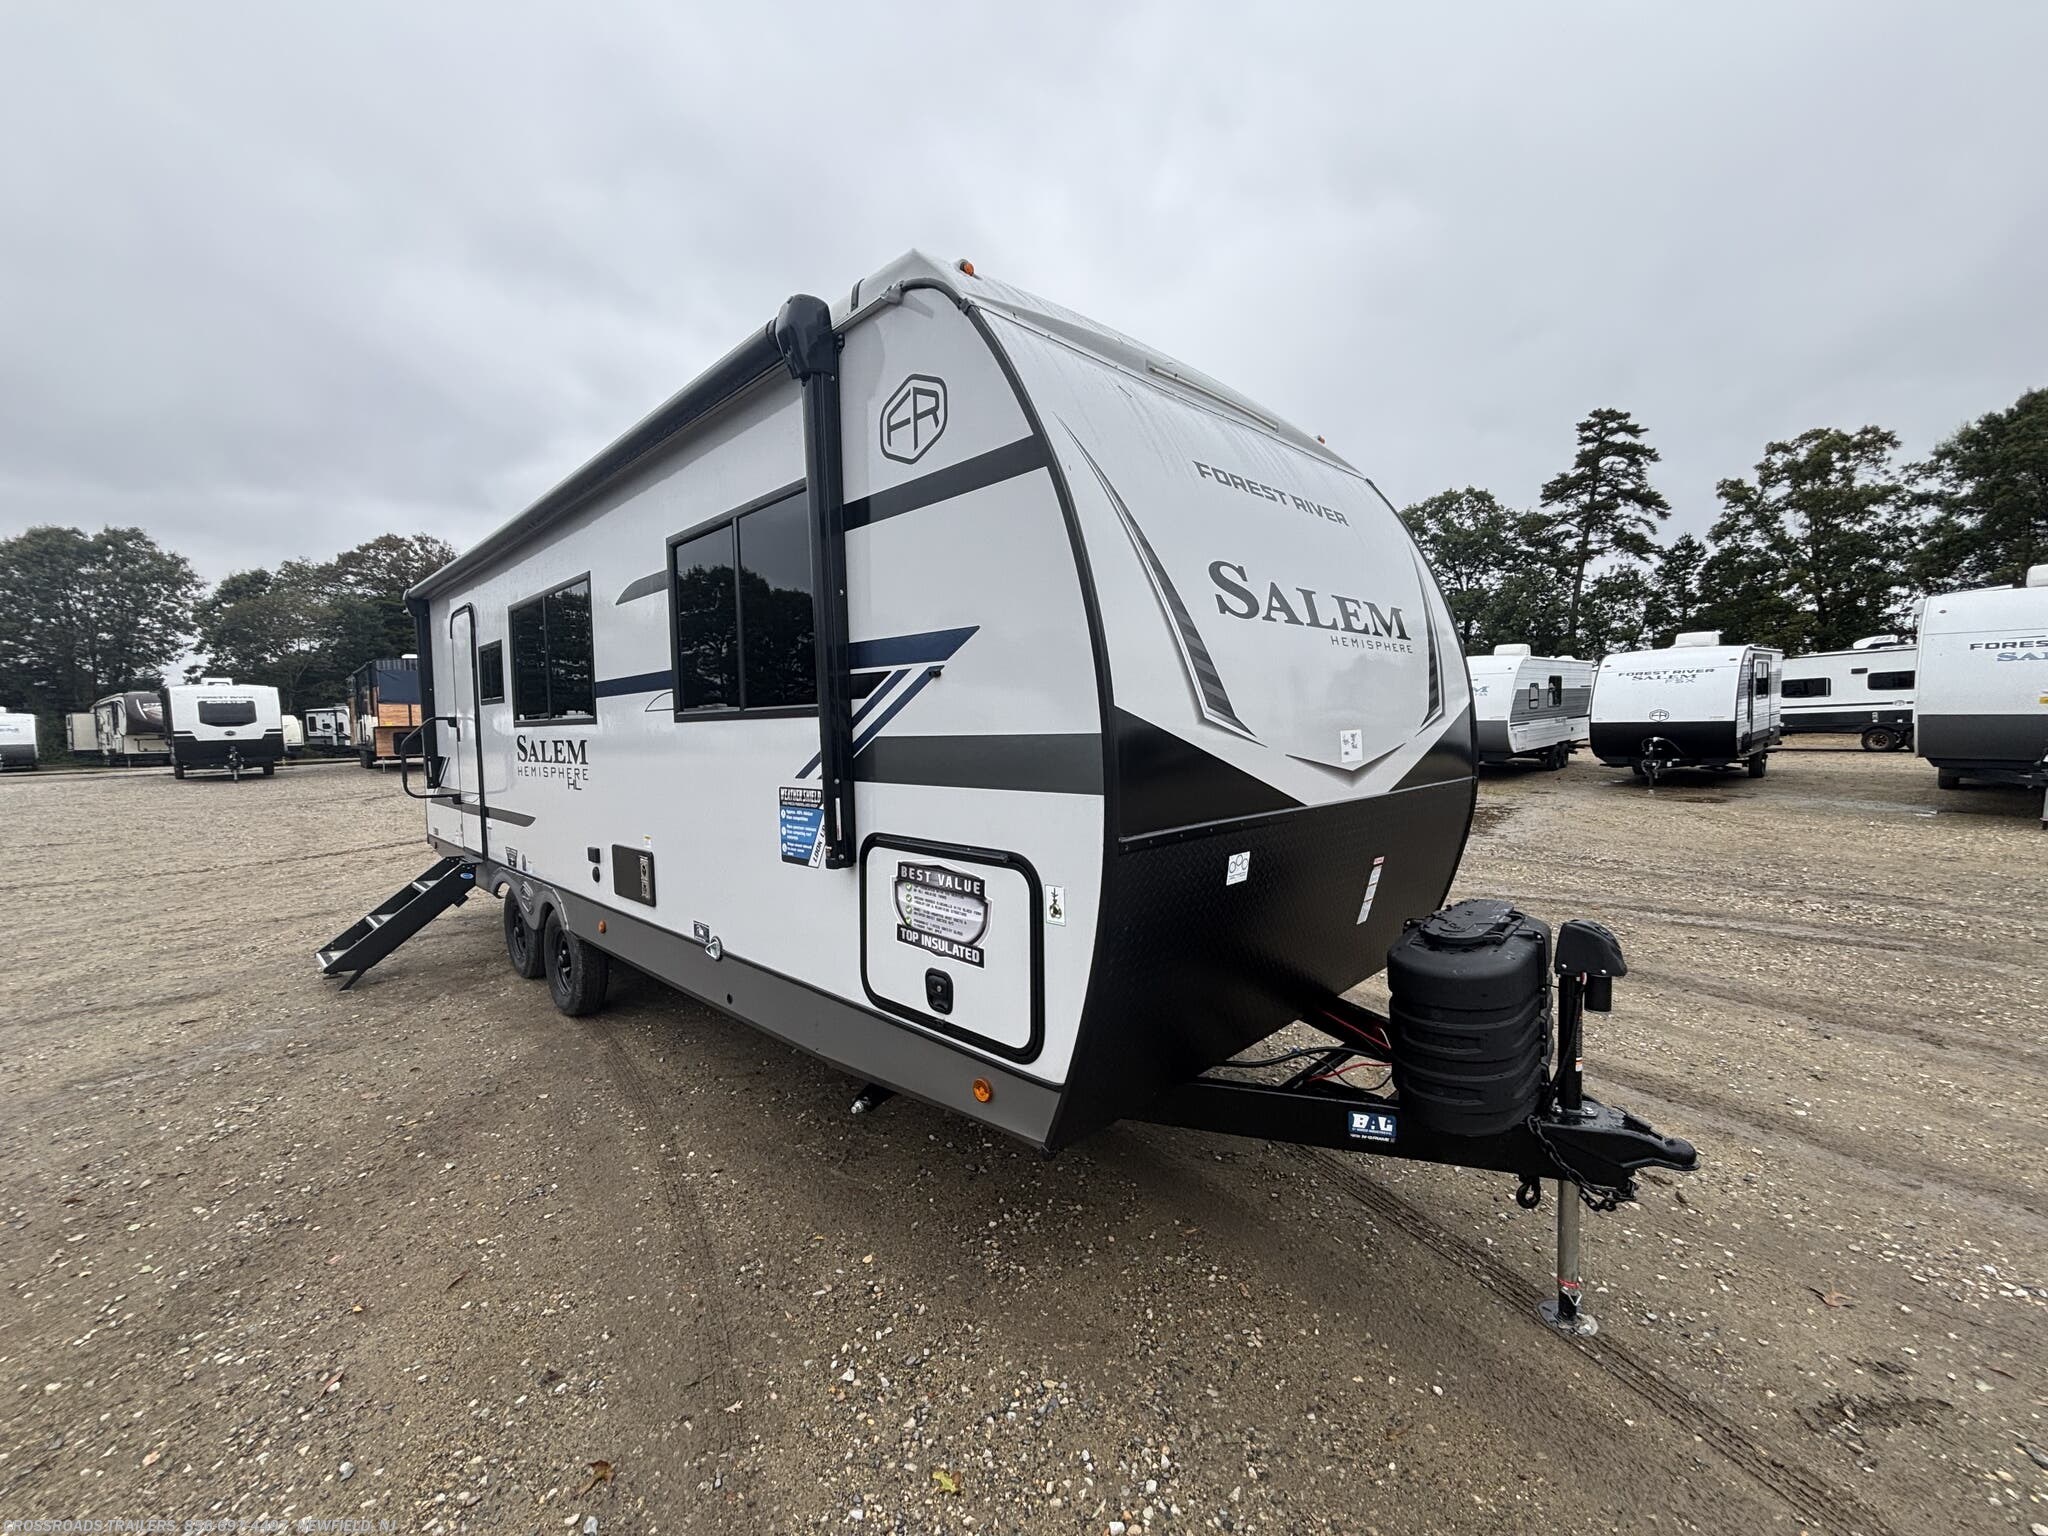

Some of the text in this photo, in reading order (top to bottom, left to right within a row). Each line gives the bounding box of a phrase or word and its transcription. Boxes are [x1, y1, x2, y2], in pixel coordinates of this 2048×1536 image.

[1192, 460, 1351, 528] FOREST RIVER
[1331, 635, 1414, 654] HEMISPHERE
[517, 765, 589, 781] HEMISPHERE
[567, 779, 582, 790] HL
[900, 866, 931, 883] BEST
[937, 873, 981, 895] VALUE
[900, 927, 919, 943] TOP
[921, 933, 980, 963] INSULATED
[1352, 1113, 1393, 1131] BAL
